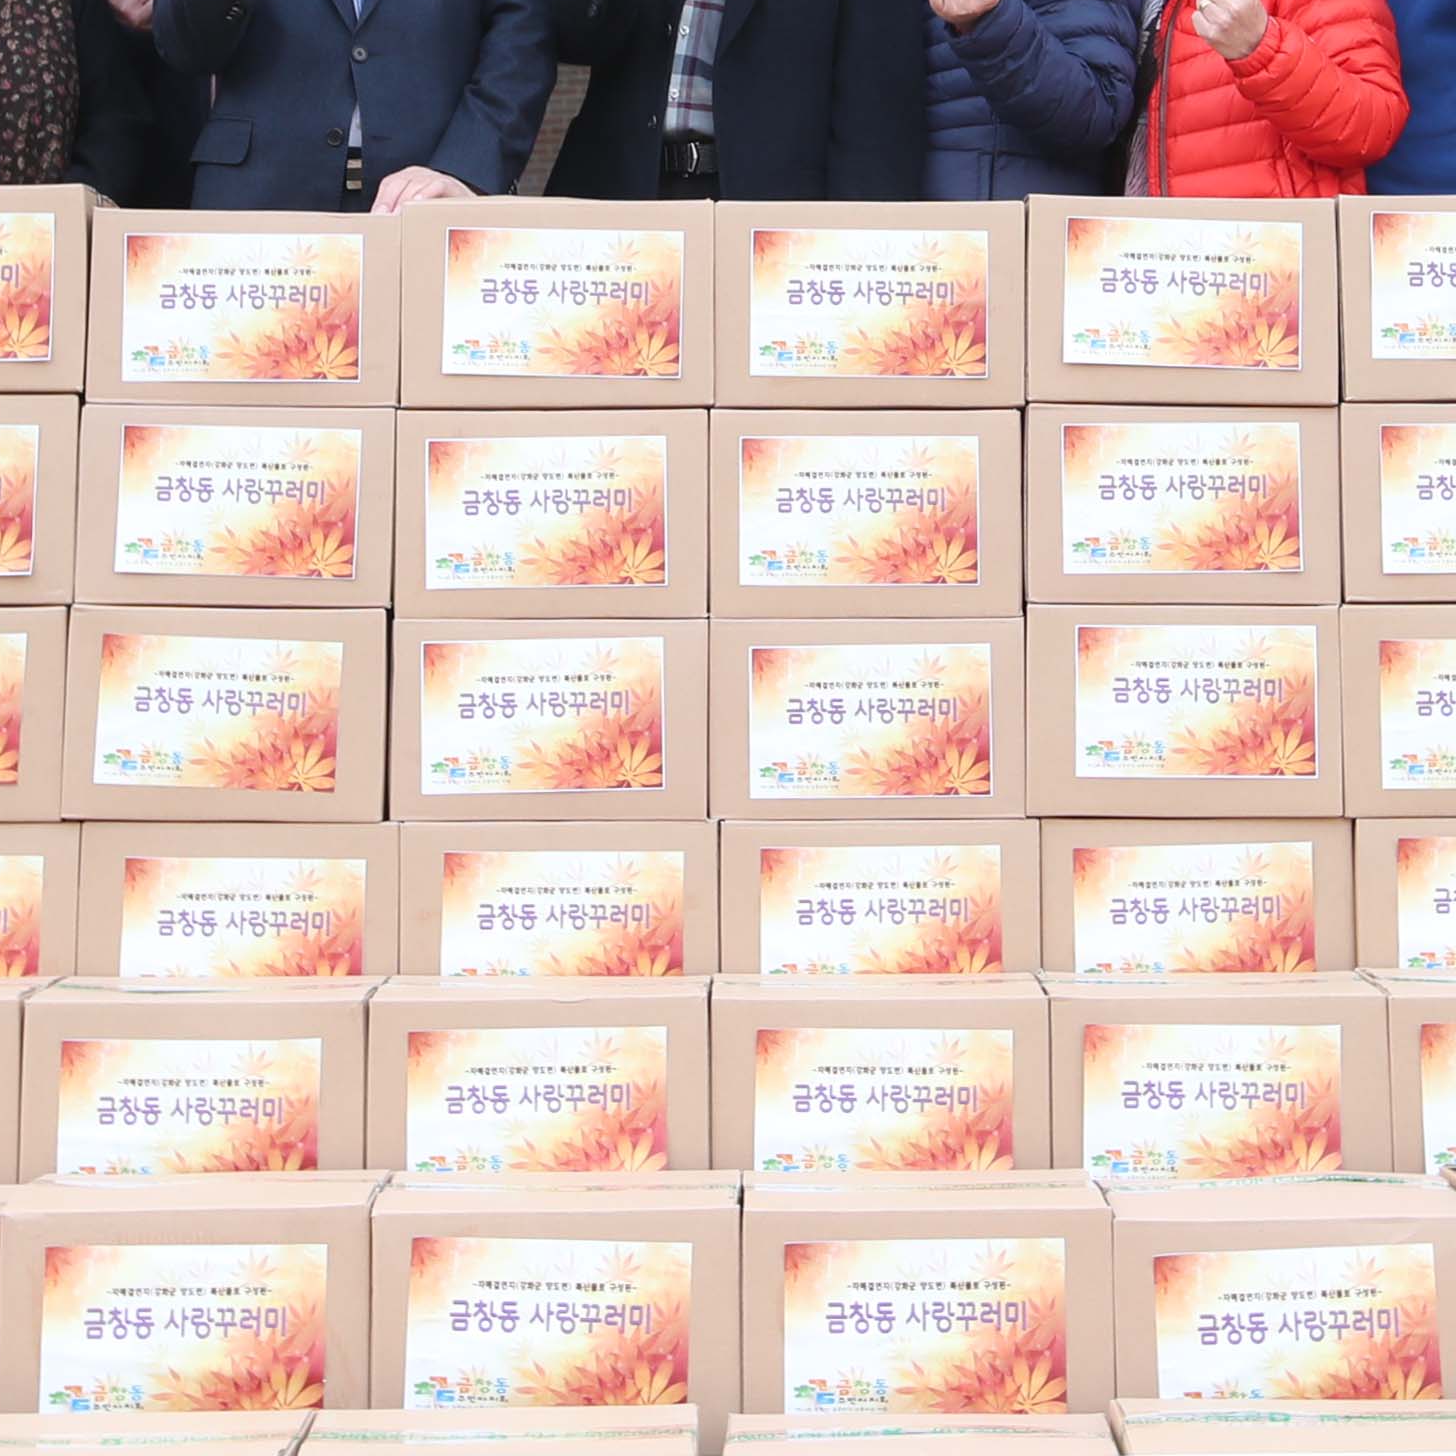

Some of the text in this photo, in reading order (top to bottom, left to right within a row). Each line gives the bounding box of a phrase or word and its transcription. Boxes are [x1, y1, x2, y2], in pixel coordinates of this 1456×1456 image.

[158, 284, 329, 311] 금창동 사랑꾸러미
[479, 278, 650, 307] 금창동 사랑꾸러미
[785, 279, 956, 307] 금창동 사랑꾸러미
[1099, 267, 1269, 299] 금창동 사랑꾸러미
[153, 476, 327, 507] 금창동 사랑꾸러미
[461, 488, 633, 516] 금창동 사랑꾸러미
[775, 487, 946, 514] 금창동 사랑꾸러미
[1098, 474, 1268, 501] 금창동 사랑꾸러미
[132, 686, 308, 719] 금창동 사랑꾸러미
[457, 691, 630, 719] 금창동 사랑꾸러미
[1111, 677, 1284, 705] 금창동 사랑꾸러미
[785, 698, 958, 725] 금창동 사랑꾸러미
[156, 909, 332, 939] 금창동 사랑꾸러미
[477, 903, 652, 931] 금창동 사랑꾸러미
[795, 898, 969, 926] 금창동 사랑꾸러미
[1109, 896, 1282, 925] 금창동 사랑꾸러미
[444, 1084, 632, 1114] 금창동 사랑꾸러미
[791, 1083, 979, 1115] 금창동 사랑꾸러미
[1120, 1080, 1306, 1111] 금창동 사랑꾸러미
[96, 1096, 284, 1127] 금창동 사랑꾸러미
[82, 1307, 288, 1340] 금창동 사랑꾸러미
[448, 1299, 653, 1337] 금창동 사랑꾸러미
[824, 1301, 1028, 1334] 금창동 사랑꾸러미
[1197, 1308, 1400, 1346] 금창동 사랑꾸러미
